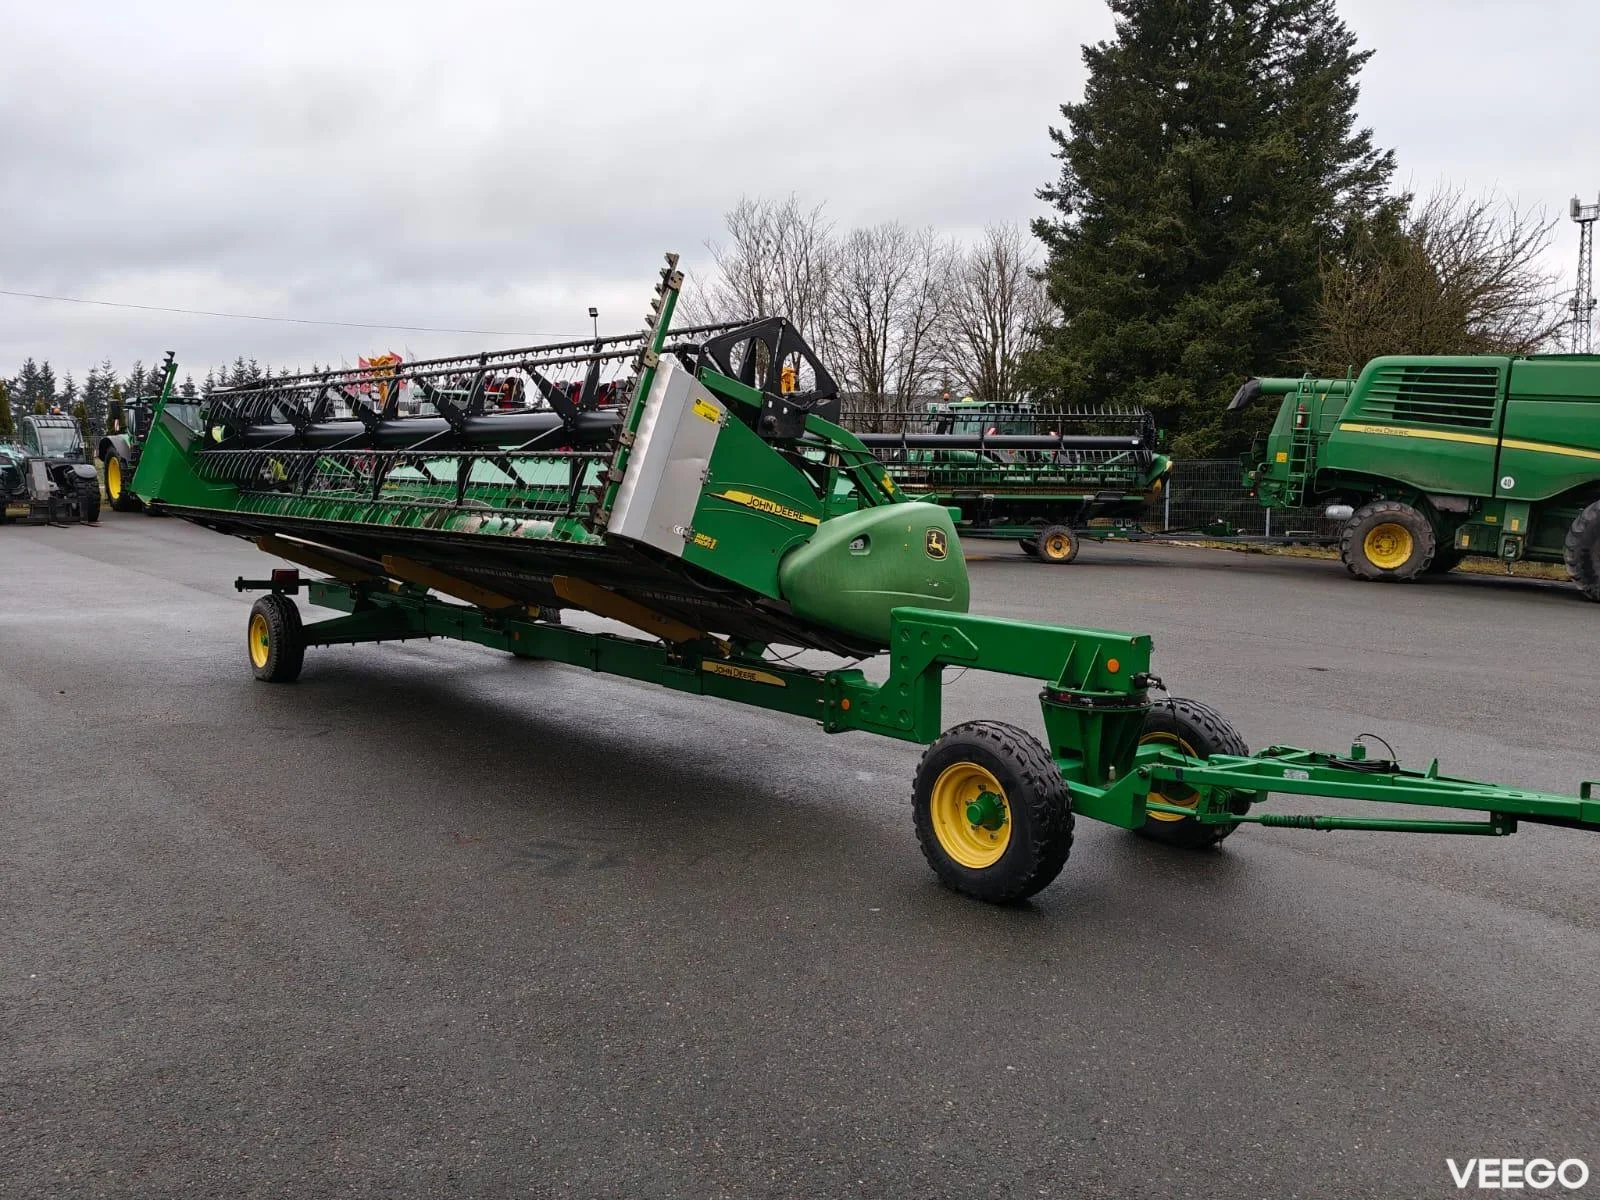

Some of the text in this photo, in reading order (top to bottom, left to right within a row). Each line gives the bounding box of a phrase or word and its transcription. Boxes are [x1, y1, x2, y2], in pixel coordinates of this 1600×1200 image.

[1364, 426, 1409, 436] JOHN DEERE
[1503, 478, 1512, 488] 40
[746, 495, 805, 521] JOHN DEERE
[714, 664, 757, 681] JOHN DEERE
